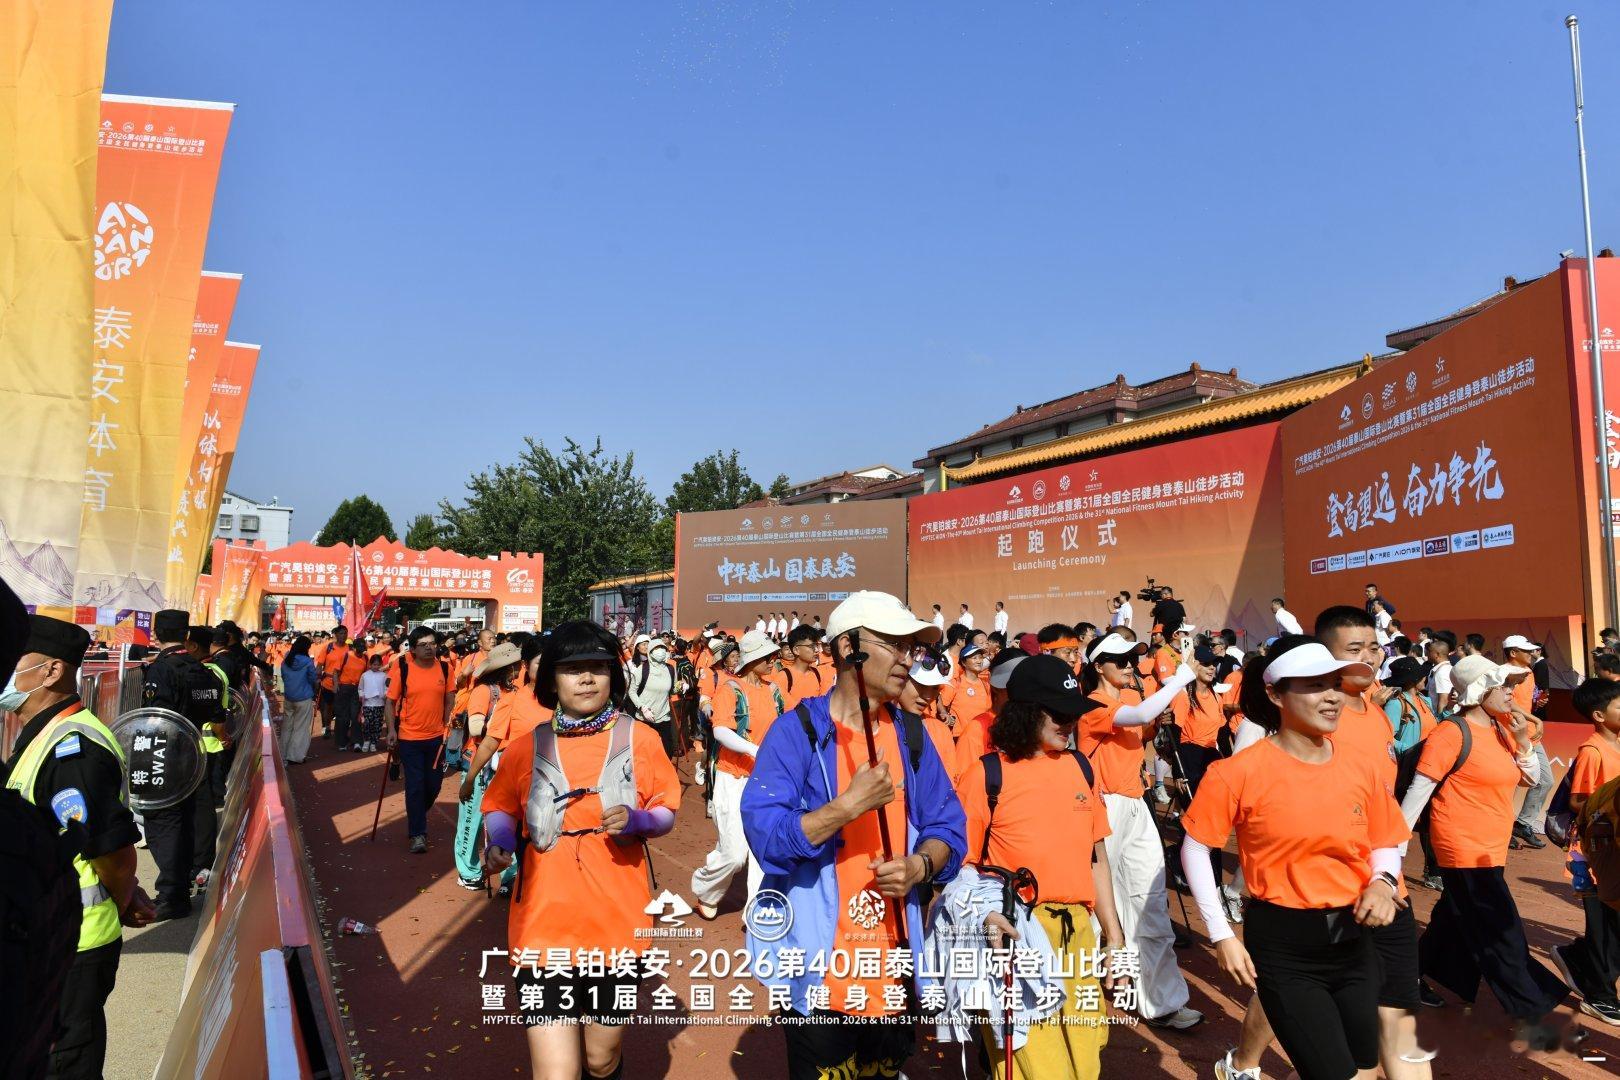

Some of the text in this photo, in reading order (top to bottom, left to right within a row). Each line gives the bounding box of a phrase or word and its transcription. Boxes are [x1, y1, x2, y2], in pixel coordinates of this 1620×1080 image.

[1403, 440, 1505, 518] 奋力争先
[1084, 510, 1094, 519] the
[1105, 504, 1132, 515] National
[1132, 501, 1155, 512] Fitness
[1156, 498, 1177, 509] Mount
[1178, 496, 1189, 505] Tai
[1190, 493, 1214, 504] Hiking
[1214, 488, 1244, 500] Activity
[997, 519, 1118, 558] 起跑仪式
[268, 562, 492, 579] 广汽昊铂埃安·26第40届泰山国际登山比赛
[717, 551, 857, 586] 中华泰山 国泰民安
[1013, 554, 1107, 571] Launching Ceremony
[268, 573, 492, 589] 暨第31届全国民健身登泰山徒步活动
[131, 735, 152, 785] 特警
[151, 736, 167, 786] SWAT
